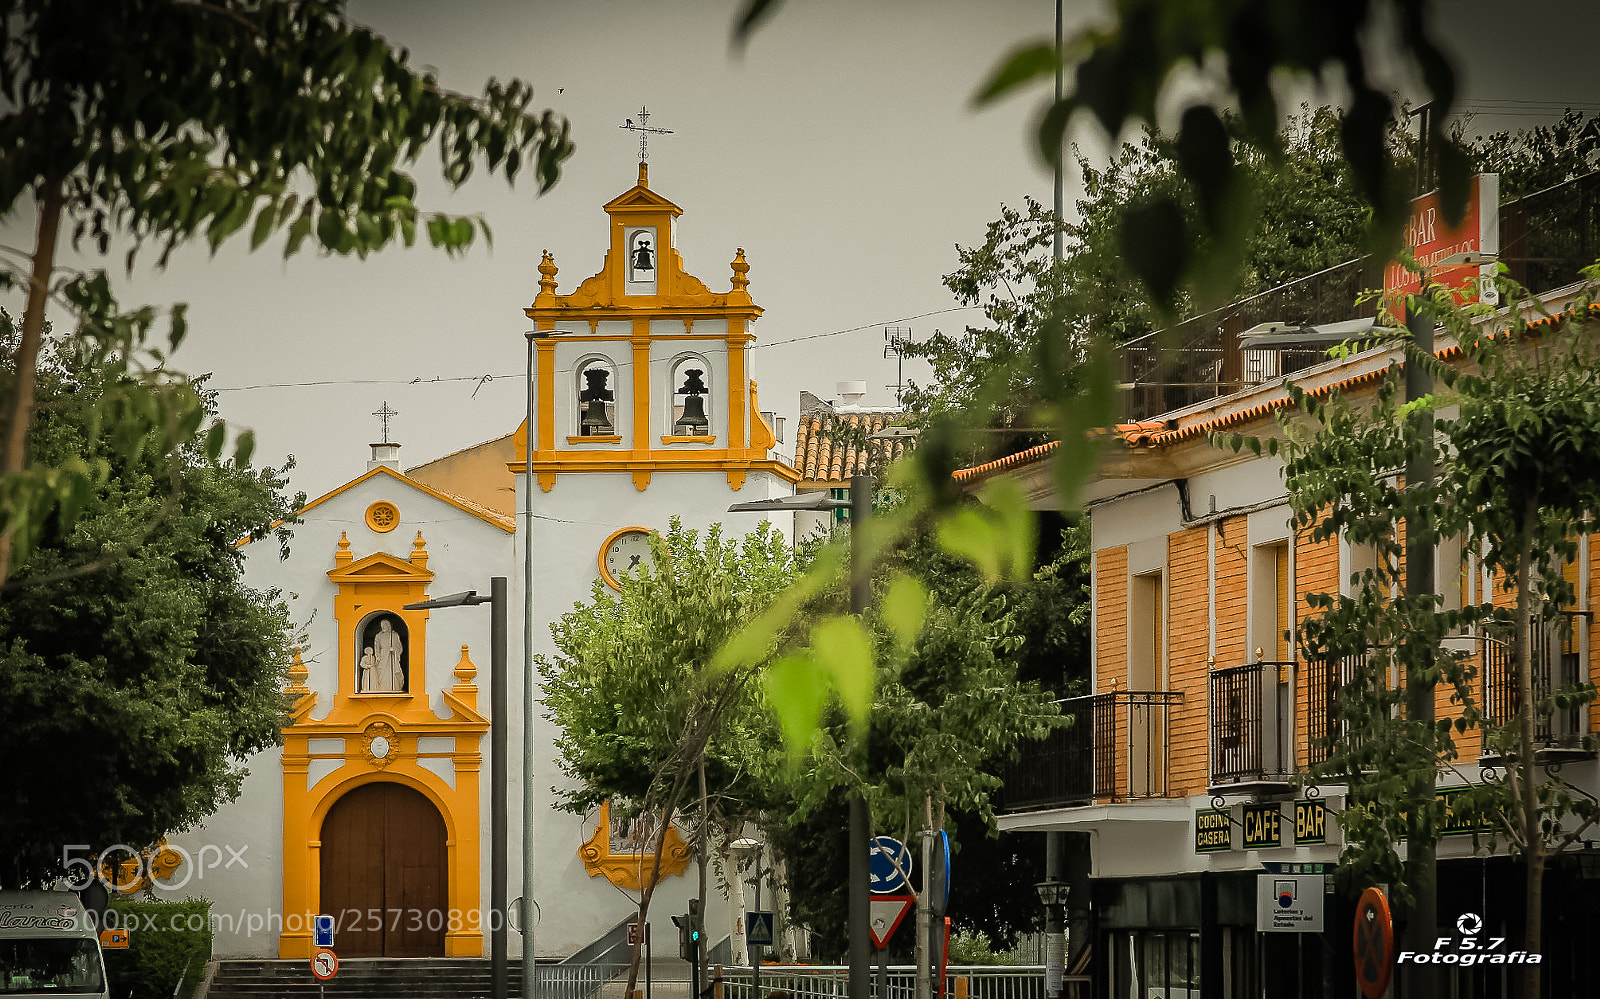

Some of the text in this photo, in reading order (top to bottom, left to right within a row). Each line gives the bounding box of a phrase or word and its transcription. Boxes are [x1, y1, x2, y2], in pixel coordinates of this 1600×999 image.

[1409, 207, 1436, 247] BAR
[1198, 814, 1230, 829] COCINA
[1297, 805, 1324, 838] BAR
[1197, 830, 1230, 846] CASERA
